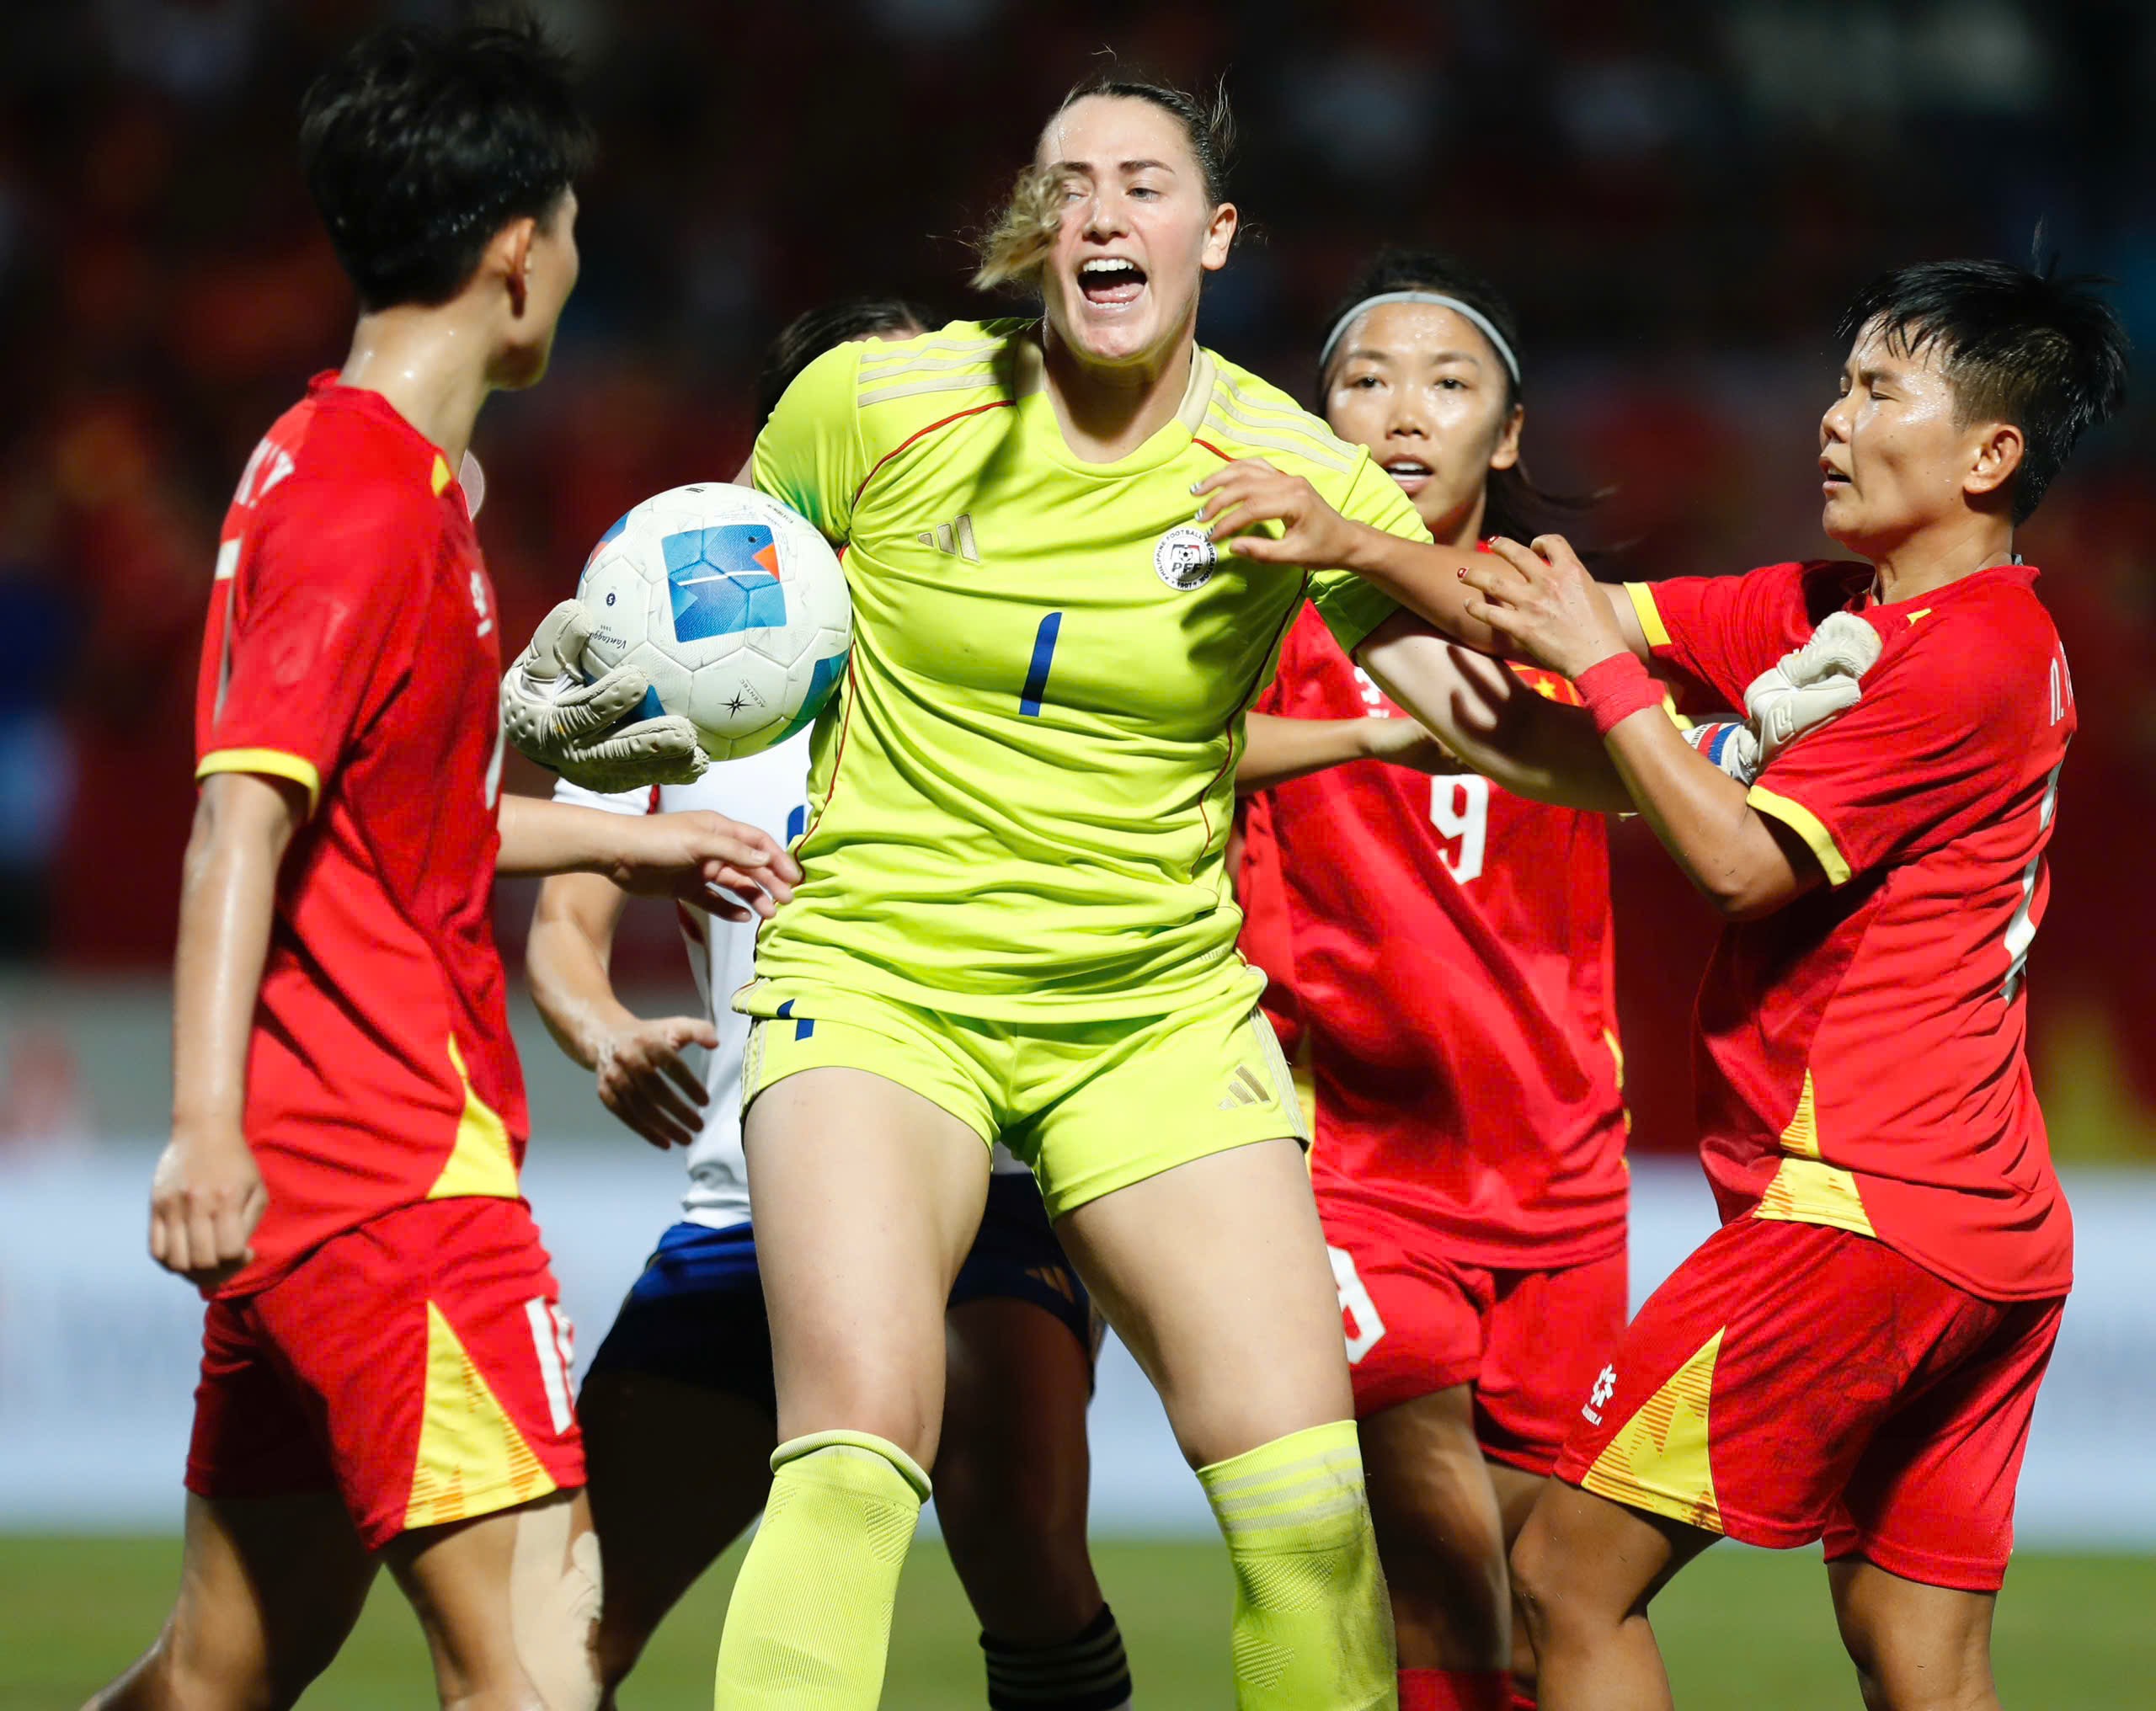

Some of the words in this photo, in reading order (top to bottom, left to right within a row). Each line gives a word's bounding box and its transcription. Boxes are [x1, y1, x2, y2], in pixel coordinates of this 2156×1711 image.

[1166, 530, 1202, 540] FOOTBALL
[1171, 562, 1203, 573] PFF
[1018, 611, 1063, 717] 1
[1429, 773, 1489, 885] 9
